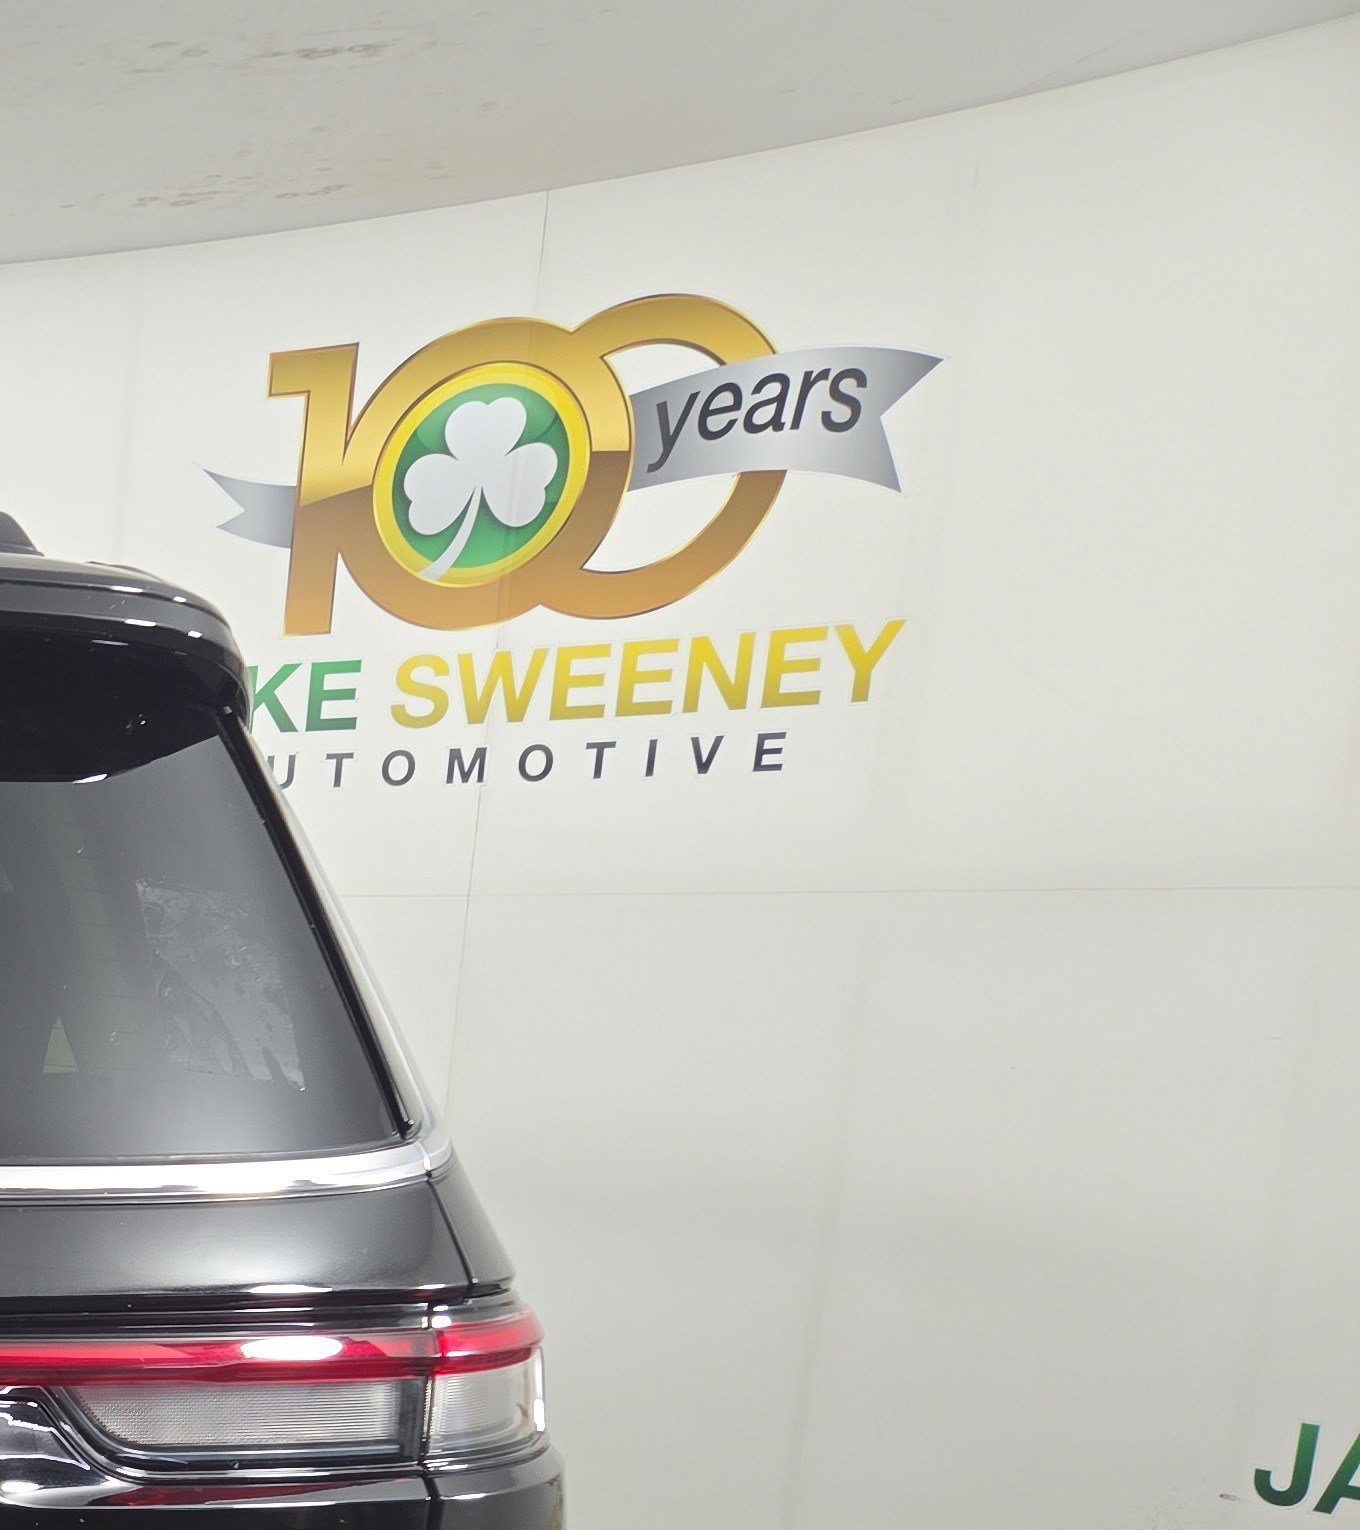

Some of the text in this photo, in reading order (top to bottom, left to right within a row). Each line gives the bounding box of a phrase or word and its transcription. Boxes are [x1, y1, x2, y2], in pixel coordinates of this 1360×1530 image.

[267, 293, 867, 636] 100 years
[391, 619, 907, 730] SWEENEY
